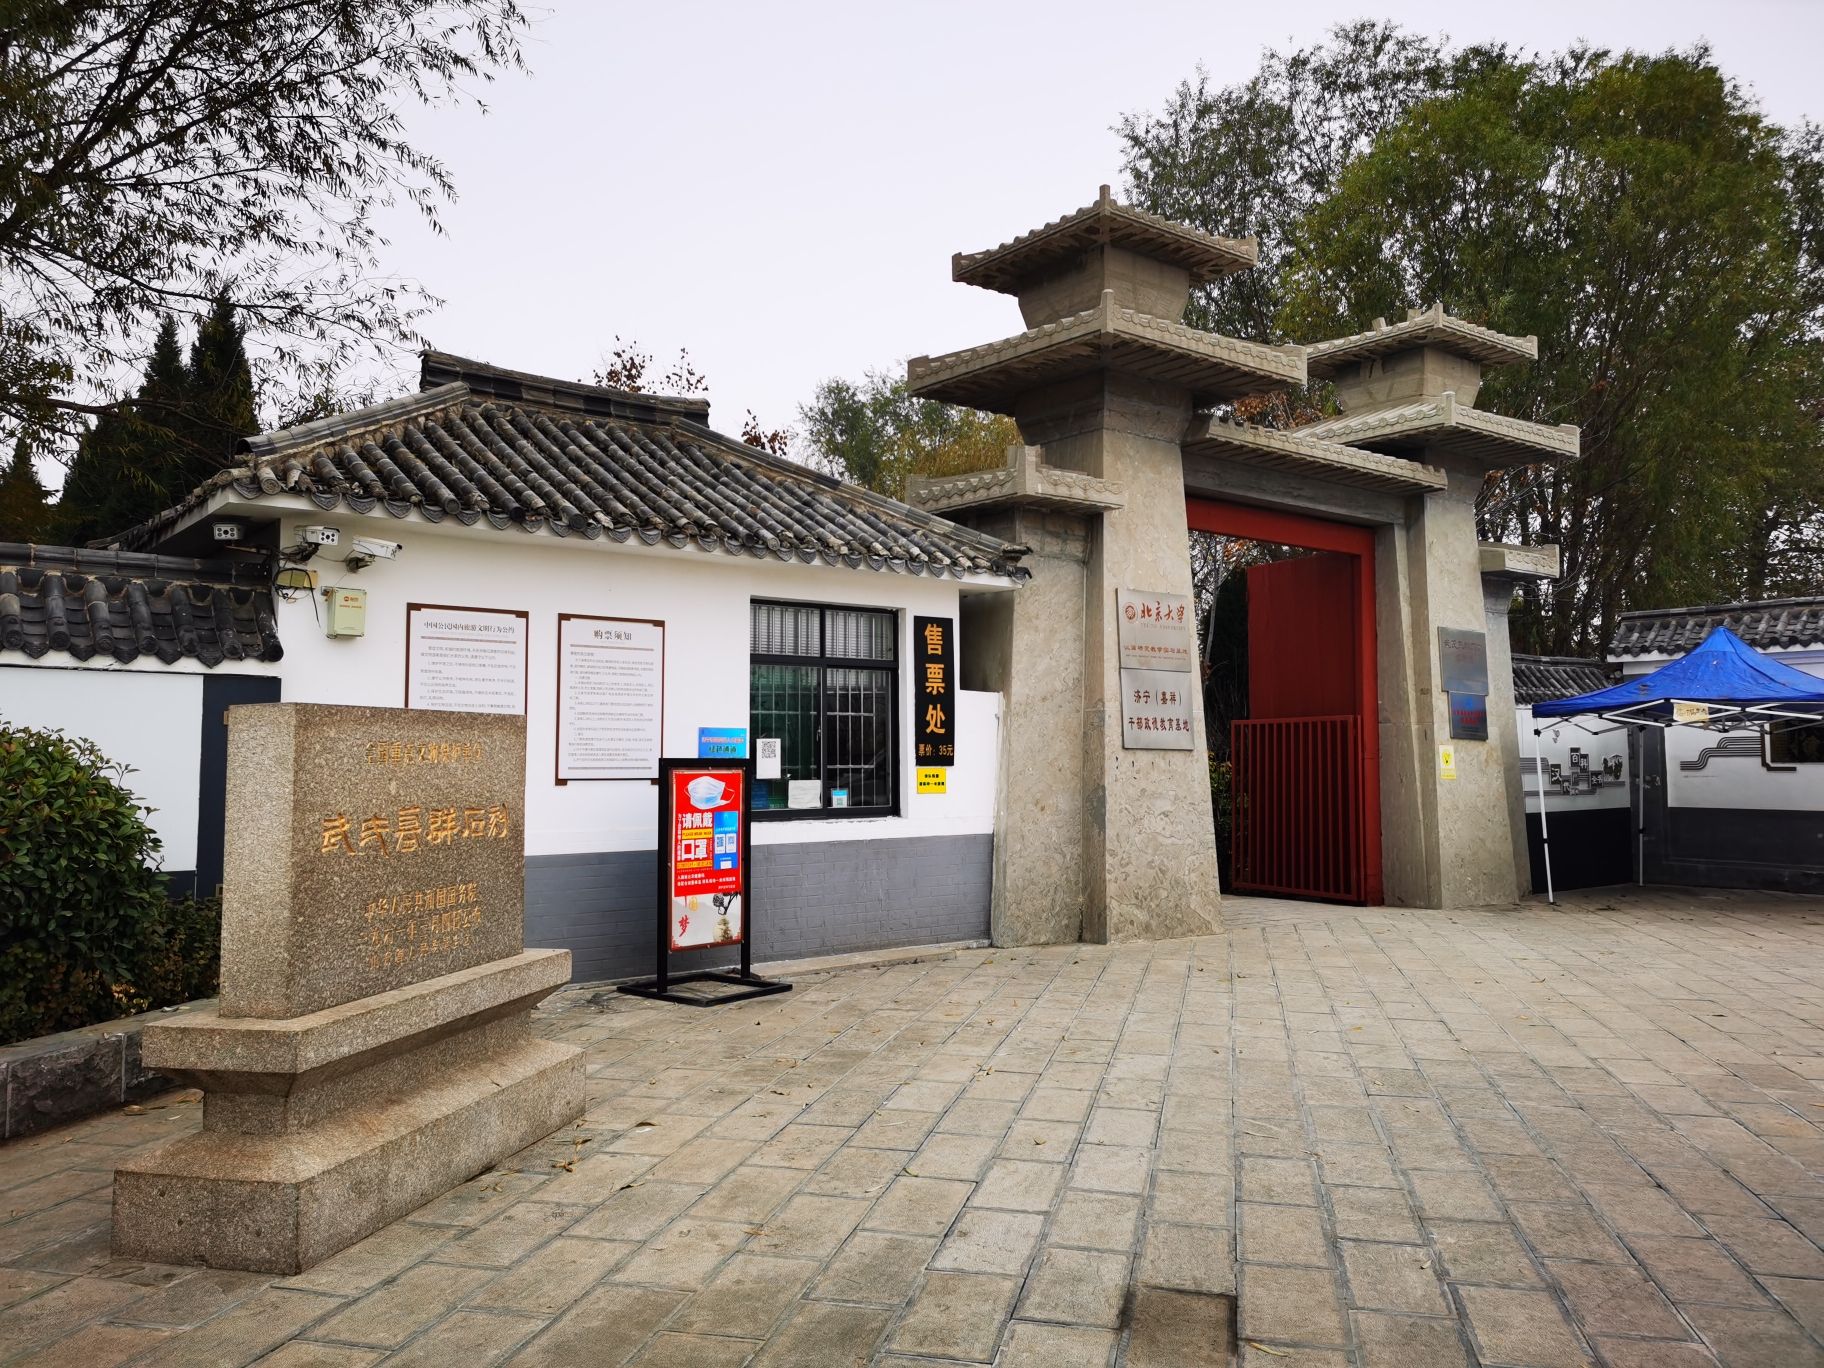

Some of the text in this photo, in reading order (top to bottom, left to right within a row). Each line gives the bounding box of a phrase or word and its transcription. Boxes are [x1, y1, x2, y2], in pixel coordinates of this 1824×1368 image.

[1140, 600, 1185, 623] 北京大学
[424, 621, 515, 634] 中国公民国内旅游文明行为公约
[593, 629, 633, 641] 购票须知
[924, 623, 946, 734] 售票处
[321, 803, 510, 859] 武氏墓群石刻
[682, 812, 713, 829] 请佩戴
[682, 839, 708, 860] 口罩
[678, 914, 690, 938] 梦
